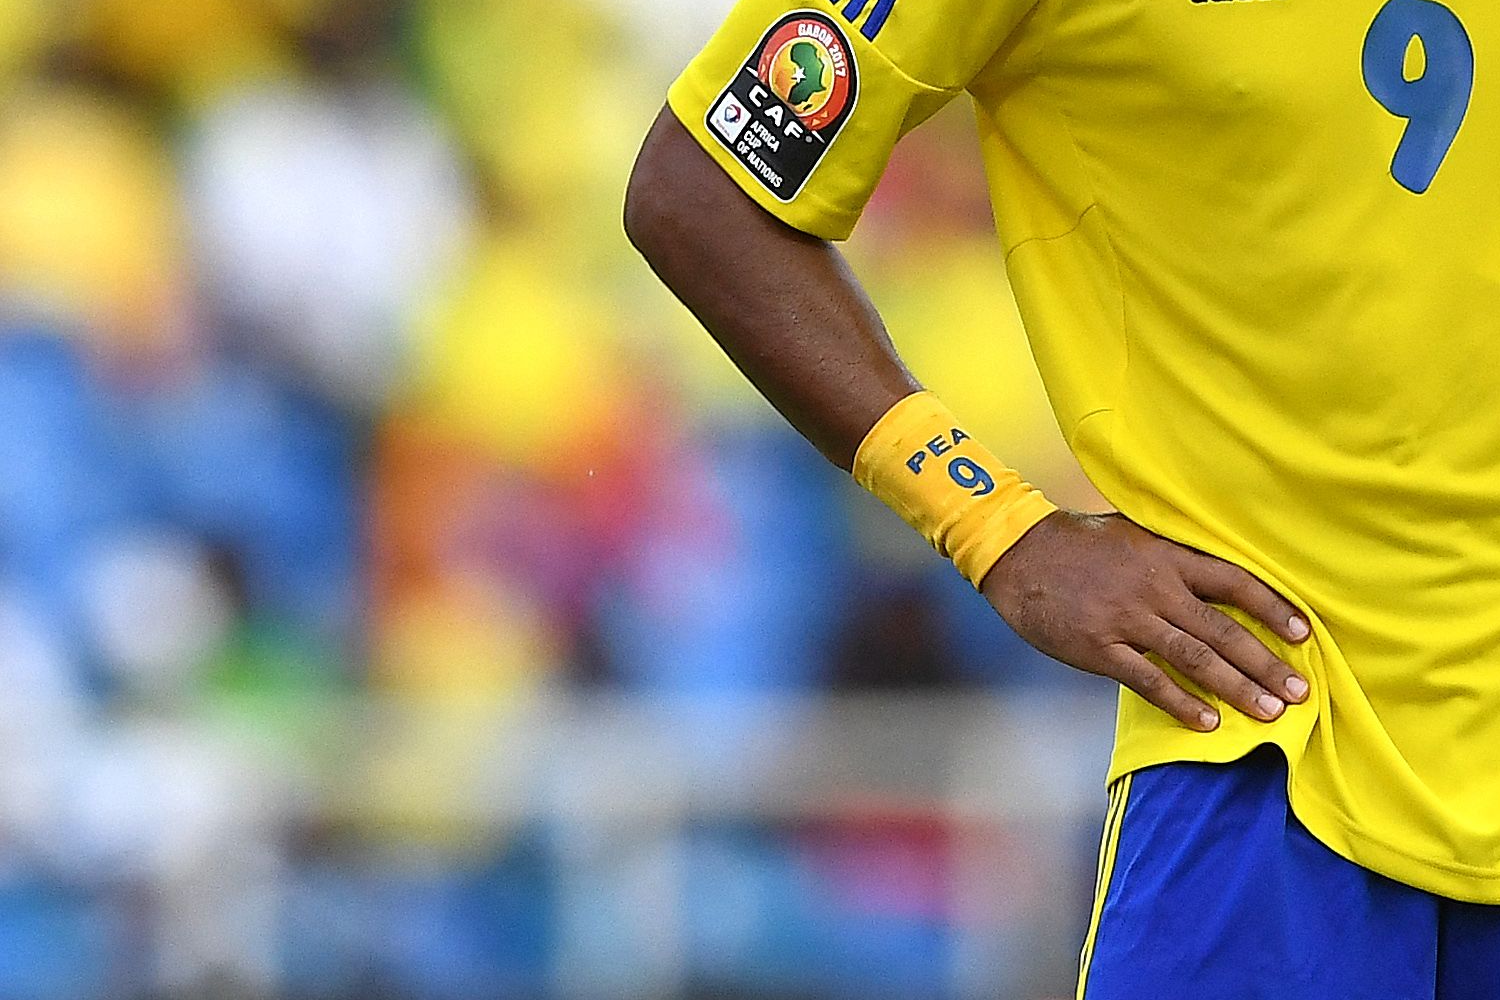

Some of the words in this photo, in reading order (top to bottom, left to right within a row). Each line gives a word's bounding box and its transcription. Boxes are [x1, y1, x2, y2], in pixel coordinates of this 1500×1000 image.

[798, 23, 833, 49] GABON
[828, 43, 847, 77] 2017
[748, 84, 804, 139] CAF
[743, 130, 763, 149] CUP
[750, 120, 780, 152] AFRICA
[736, 140, 749, 157] OF
[747, 151, 783, 188] NATIONS
[906, 427, 971, 475] PEA
[948, 456, 995, 497] 9
